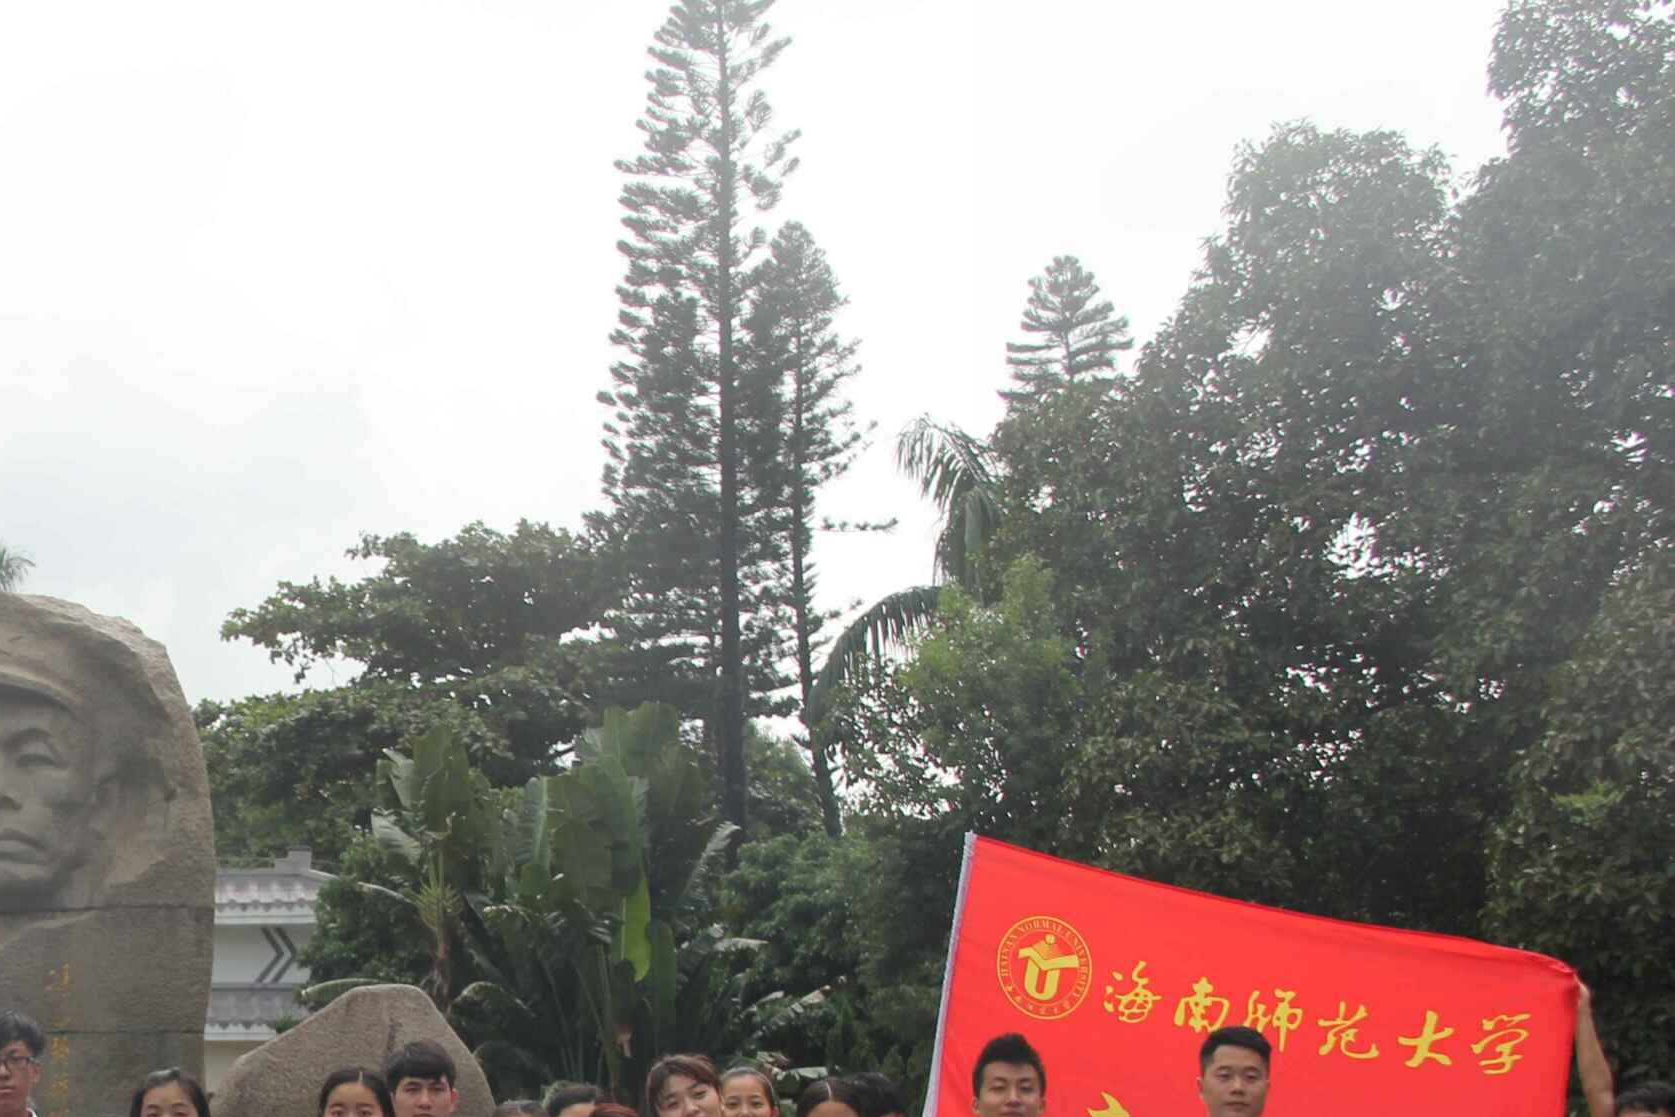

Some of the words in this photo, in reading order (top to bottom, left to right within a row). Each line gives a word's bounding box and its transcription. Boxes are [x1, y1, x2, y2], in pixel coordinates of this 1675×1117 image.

[1103, 960, 1530, 1075] 海南师范大学
